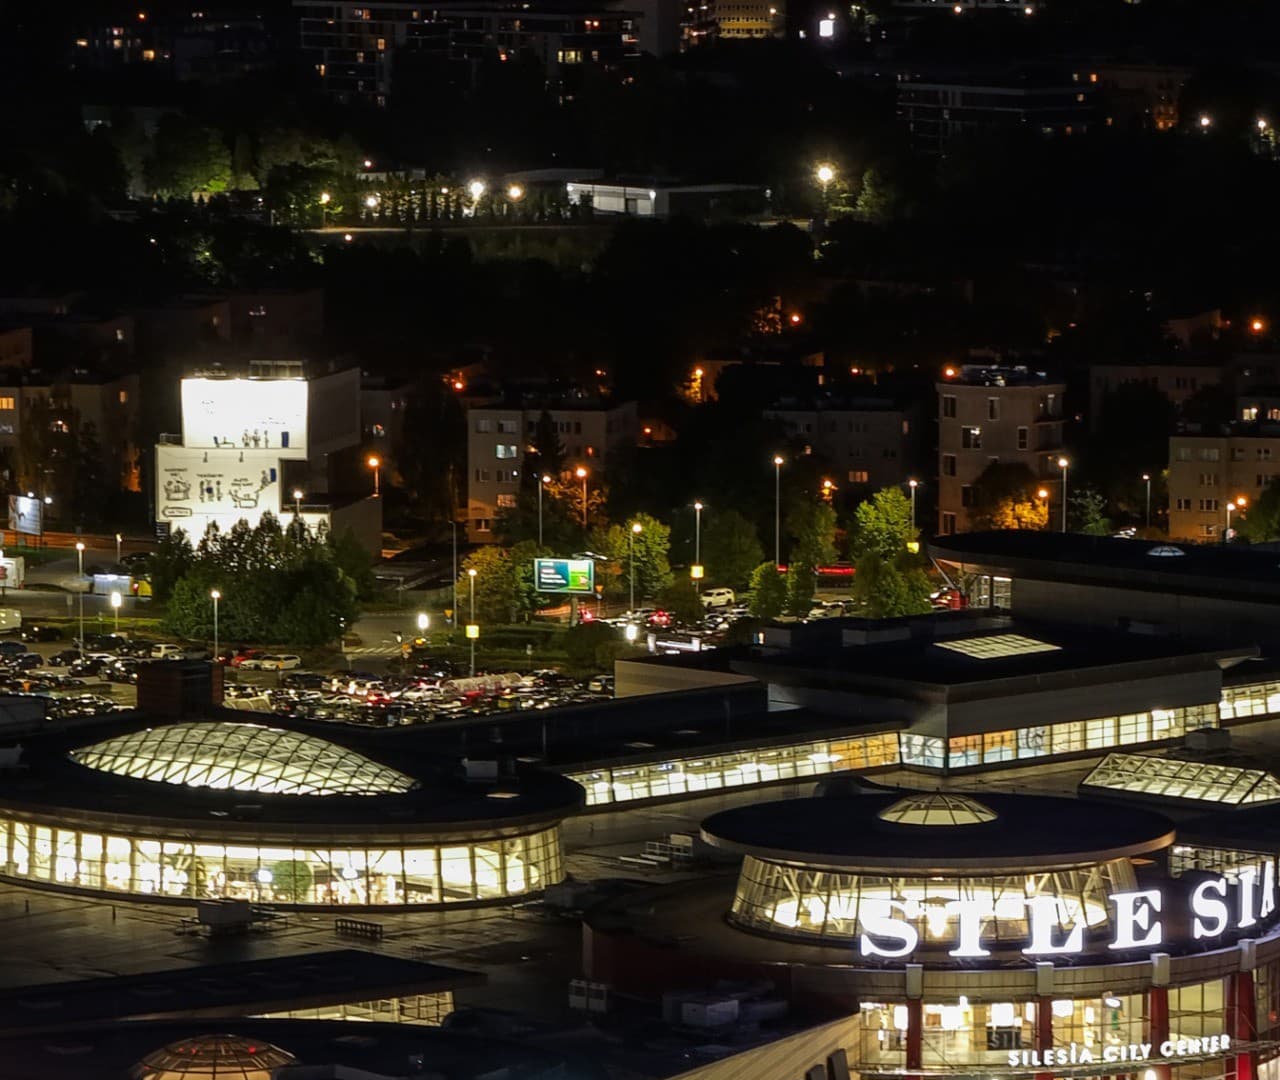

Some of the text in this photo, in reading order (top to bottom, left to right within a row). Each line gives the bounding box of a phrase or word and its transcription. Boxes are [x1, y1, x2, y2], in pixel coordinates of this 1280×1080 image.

[860, 860, 1276, 957] SILESIA
[1104, 1044, 1152, 1063] CITY
[1160, 1034, 1231, 1058] CENTER
